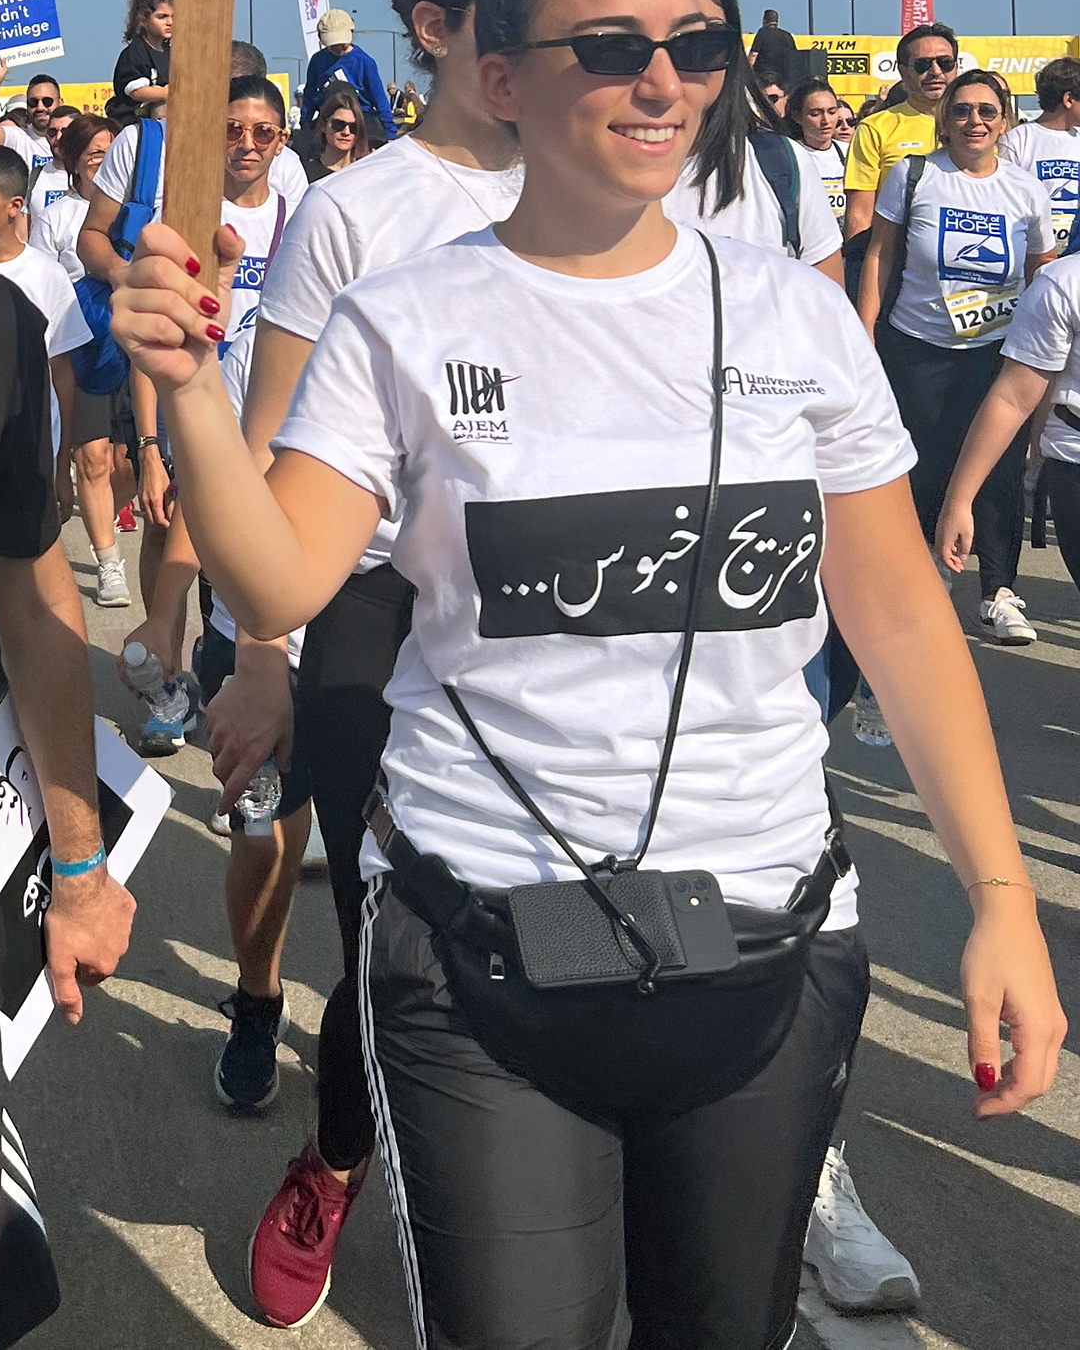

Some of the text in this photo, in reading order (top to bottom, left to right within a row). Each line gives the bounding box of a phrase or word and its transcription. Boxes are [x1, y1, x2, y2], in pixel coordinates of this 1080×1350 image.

[17, 45, 60, 58] Foundation
[836, 41, 856, 50] KM
[988, 57, 1047, 73] FINIS
[1041, 166, 1080, 179] HOPE
[946, 209, 965, 218] Our
[966, 212, 988, 222] Lady
[945, 217, 1002, 235] HOPE
[748, 384, 826, 396] Antonine
[452, 419, 509, 432] AJEM
